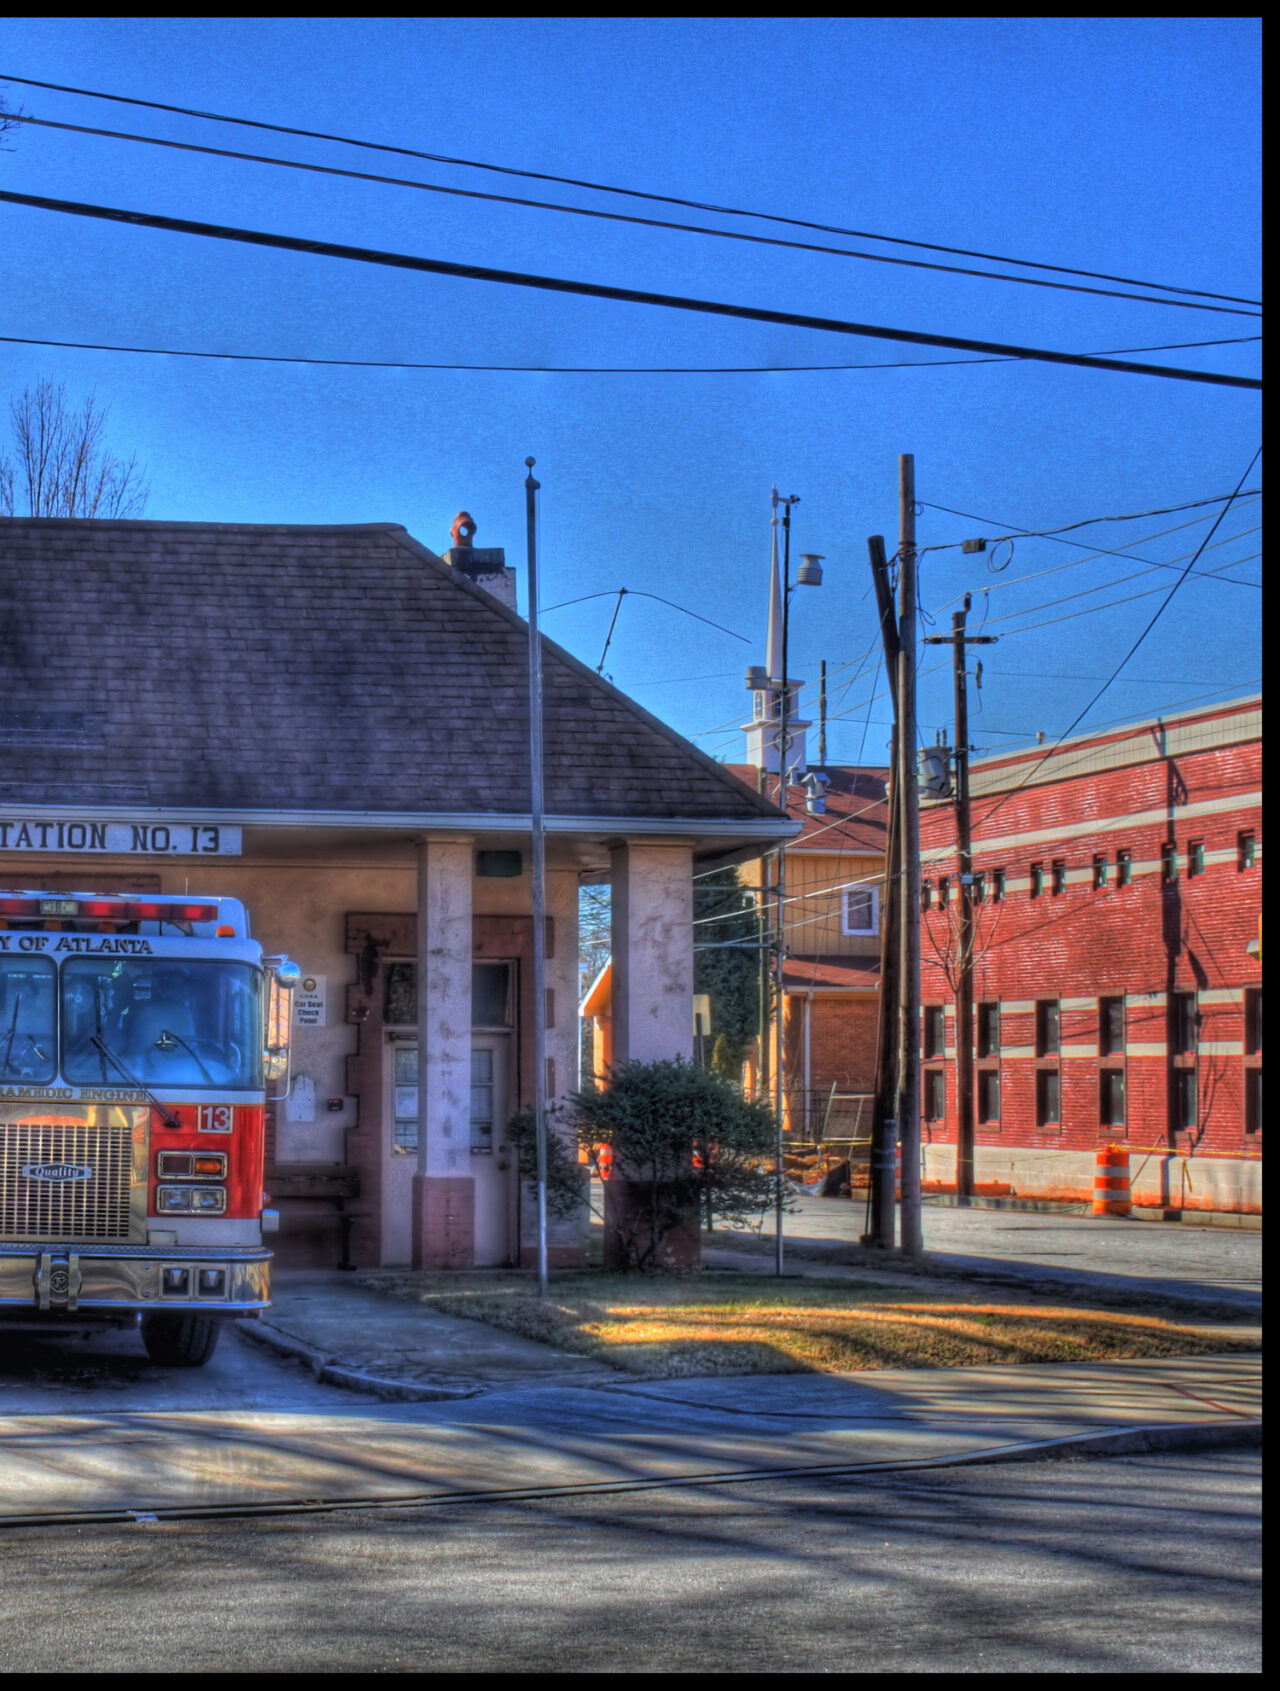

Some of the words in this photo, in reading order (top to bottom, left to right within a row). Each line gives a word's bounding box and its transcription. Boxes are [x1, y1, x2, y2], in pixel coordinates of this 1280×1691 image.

[130, 825, 177, 852] NO.
[190, 826, 219, 853] 13
[18, 935, 49, 951] OF
[54, 936, 154, 954] ATLANTA
[80, 1088, 147, 1101] ENGINE
[203, 1106, 231, 1130] 13
[35, 1166, 80, 1178] Quality
